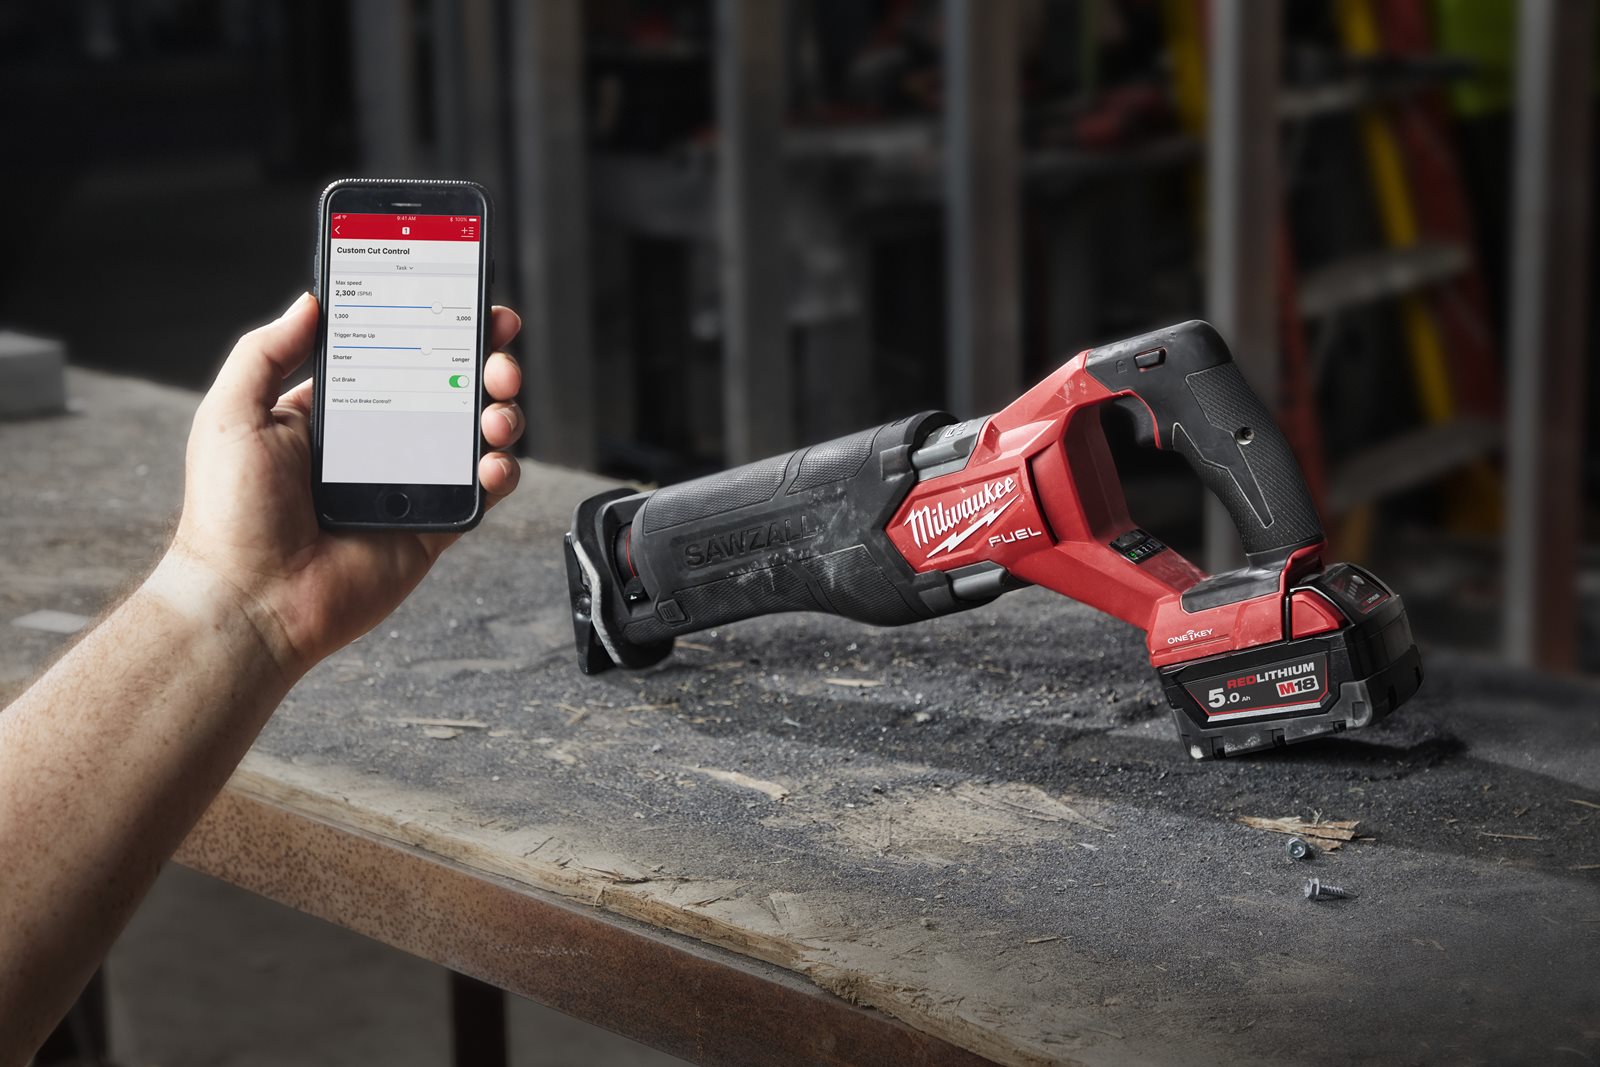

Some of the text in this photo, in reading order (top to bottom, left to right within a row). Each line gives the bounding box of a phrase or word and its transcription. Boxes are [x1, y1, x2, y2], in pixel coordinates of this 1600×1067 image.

[903, 476, 1018, 549] Milwaukee
[684, 515, 819, 568] SAWZALL
[988, 527, 1042, 548] FUEL
[1278, 677, 1316, 696] M18
[1208, 687, 1240, 708] 5.0
